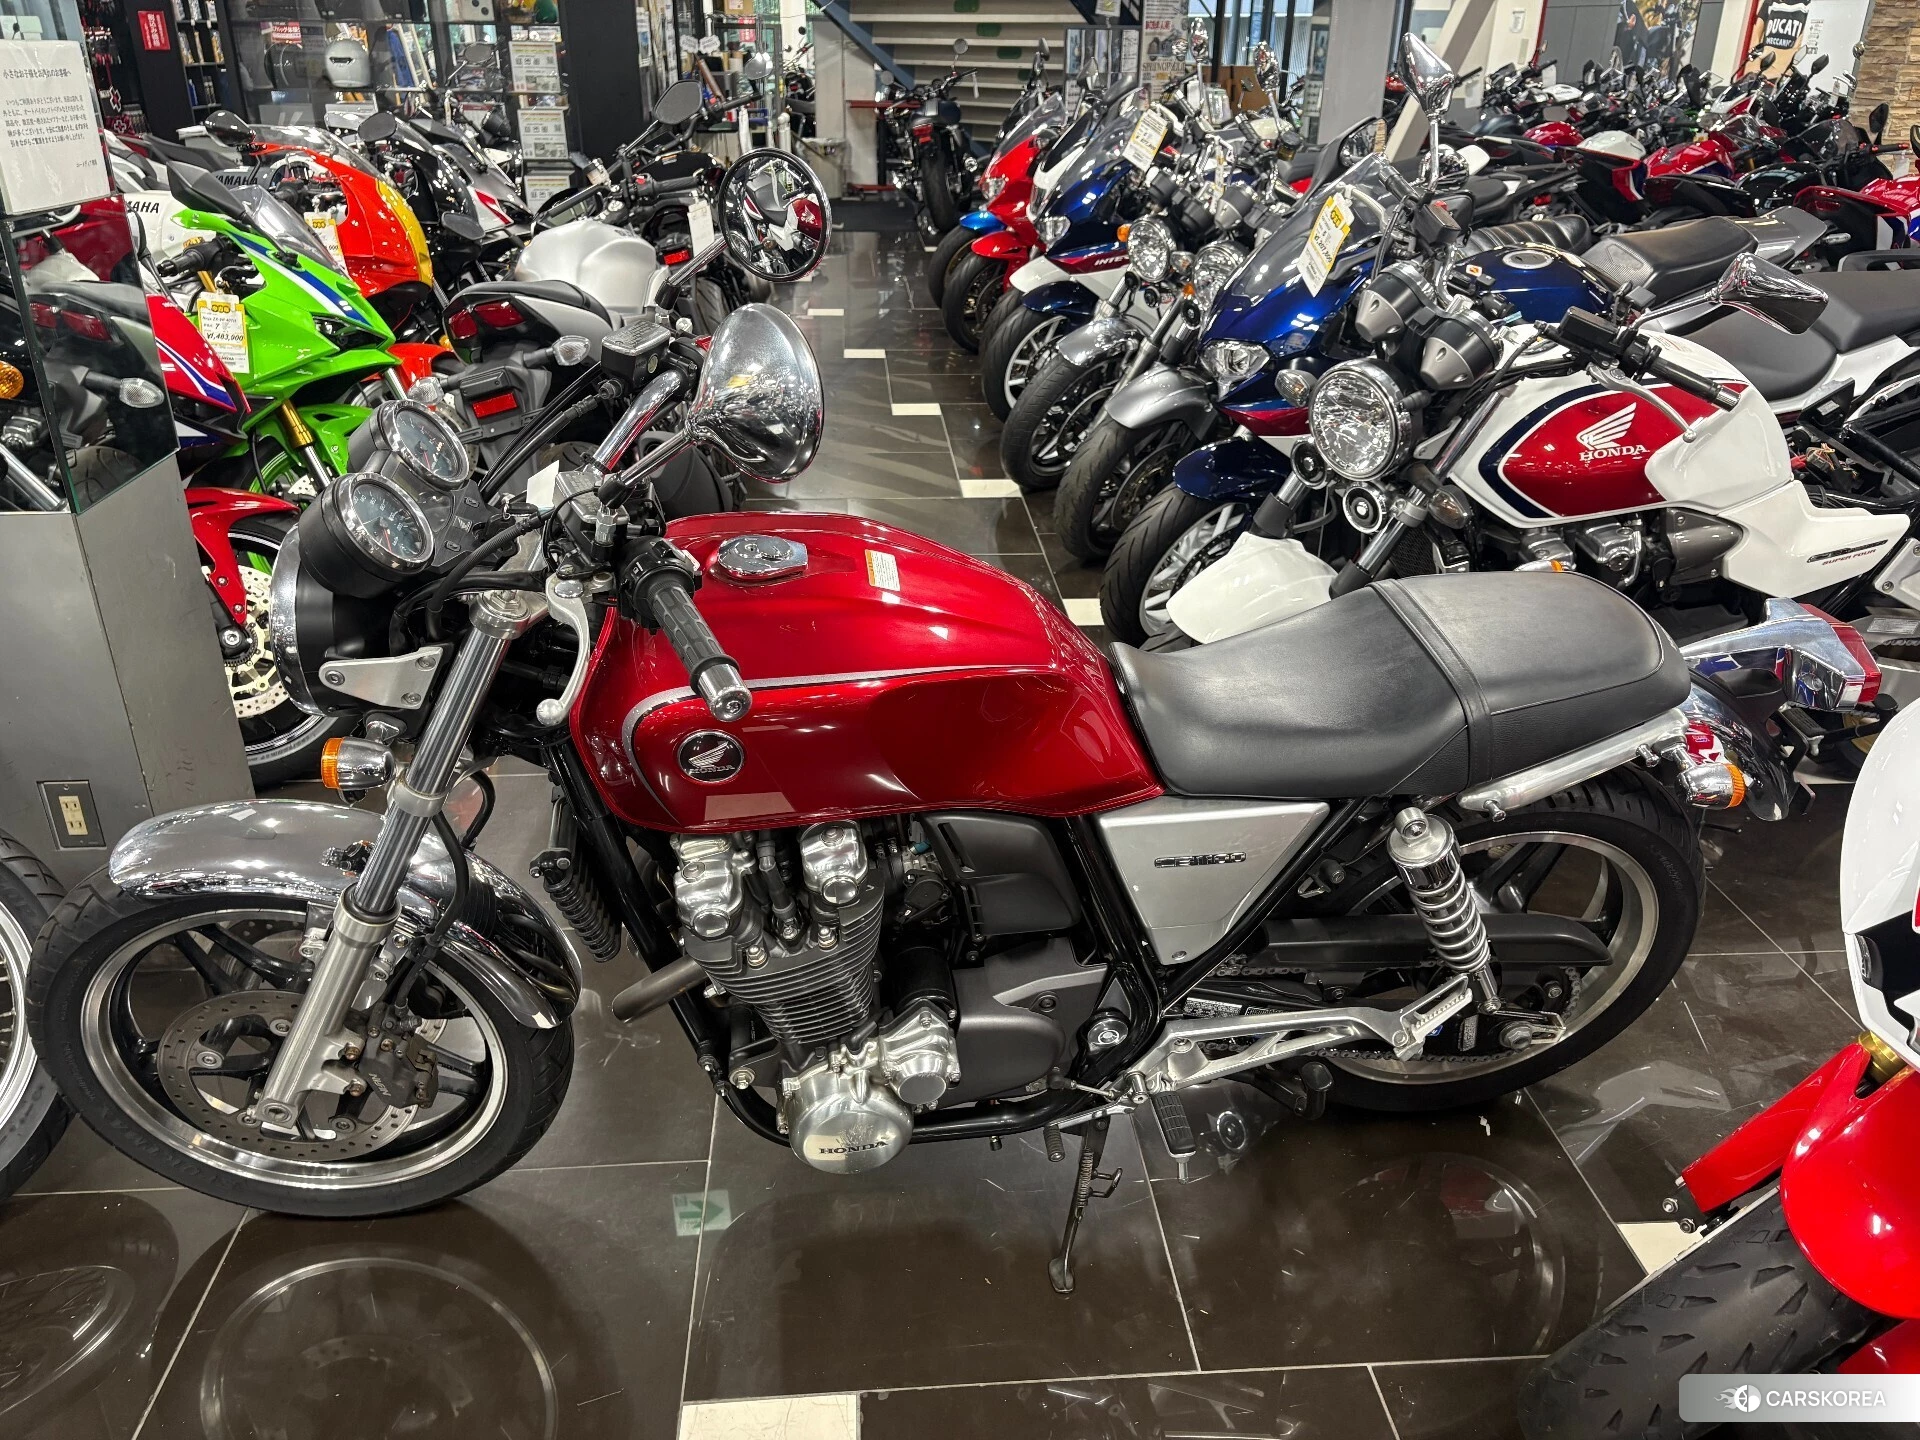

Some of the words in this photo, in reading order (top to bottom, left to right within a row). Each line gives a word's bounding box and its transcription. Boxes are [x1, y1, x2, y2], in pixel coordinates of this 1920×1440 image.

[1766, 18, 1802, 38] DUCATI
[215, 175, 258, 185] AMAHA
[1579, 444, 1650, 461] HONDA
[689, 764, 736, 775] HONDA
[819, 1140, 889, 1154] HONDA
